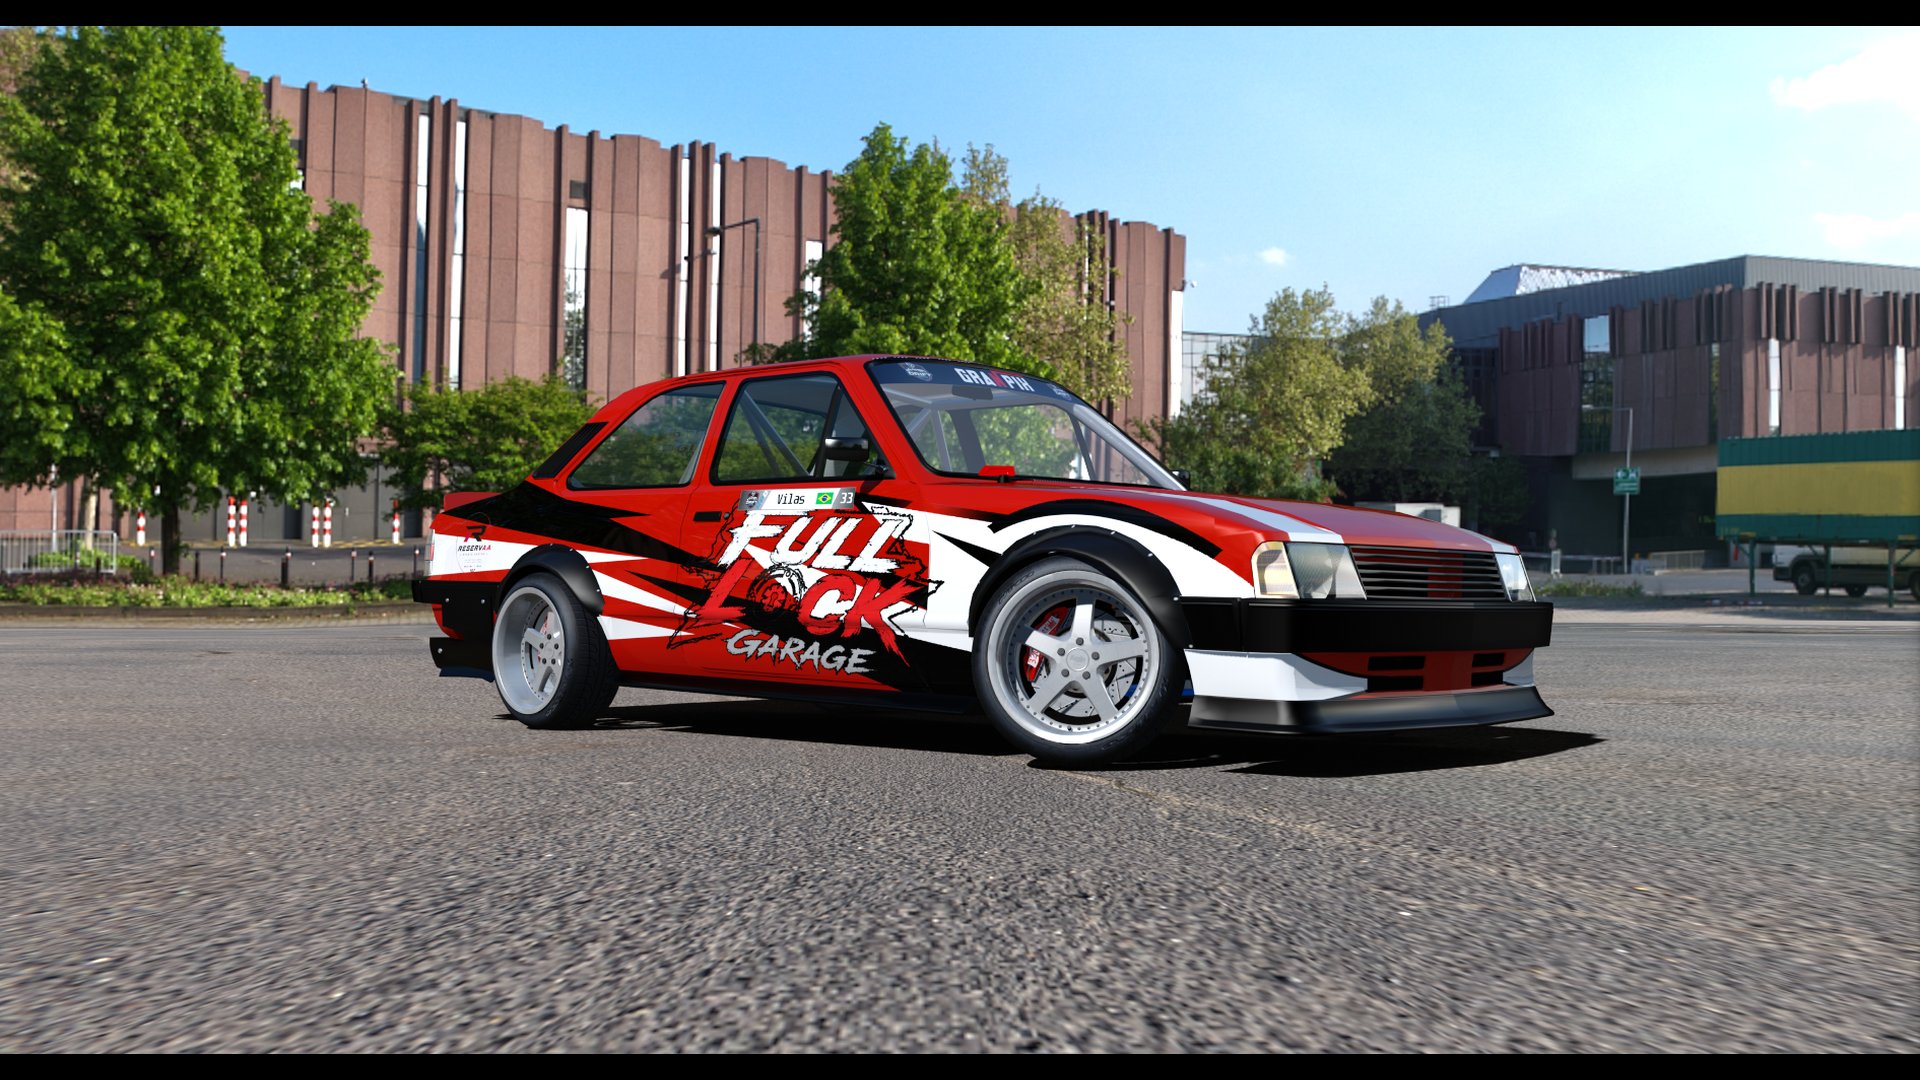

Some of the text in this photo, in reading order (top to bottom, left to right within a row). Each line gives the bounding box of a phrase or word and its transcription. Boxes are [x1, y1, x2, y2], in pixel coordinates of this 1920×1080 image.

[777, 492, 853, 505] Vilas 33
[717, 509, 903, 573] FULL
[696, 558, 925, 668] LOCK
[724, 629, 877, 674] GARAGE
